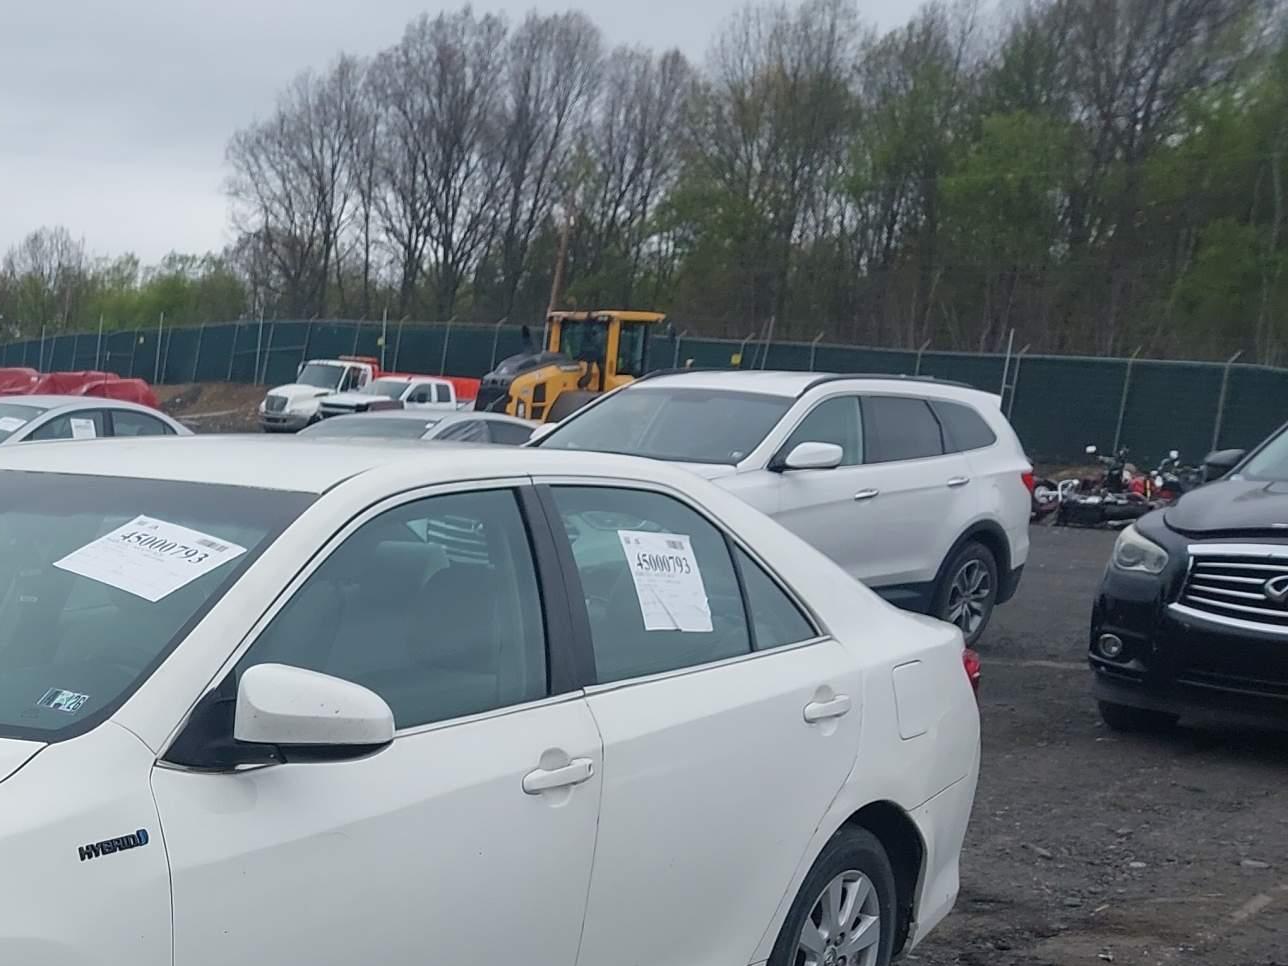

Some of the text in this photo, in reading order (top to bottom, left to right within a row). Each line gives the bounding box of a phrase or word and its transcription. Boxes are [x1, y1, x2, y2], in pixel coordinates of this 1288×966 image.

[120, 531, 209, 564] 45000793
[636, 552, 691, 574] 45000793
[78, 833, 139, 861] HYBRID
